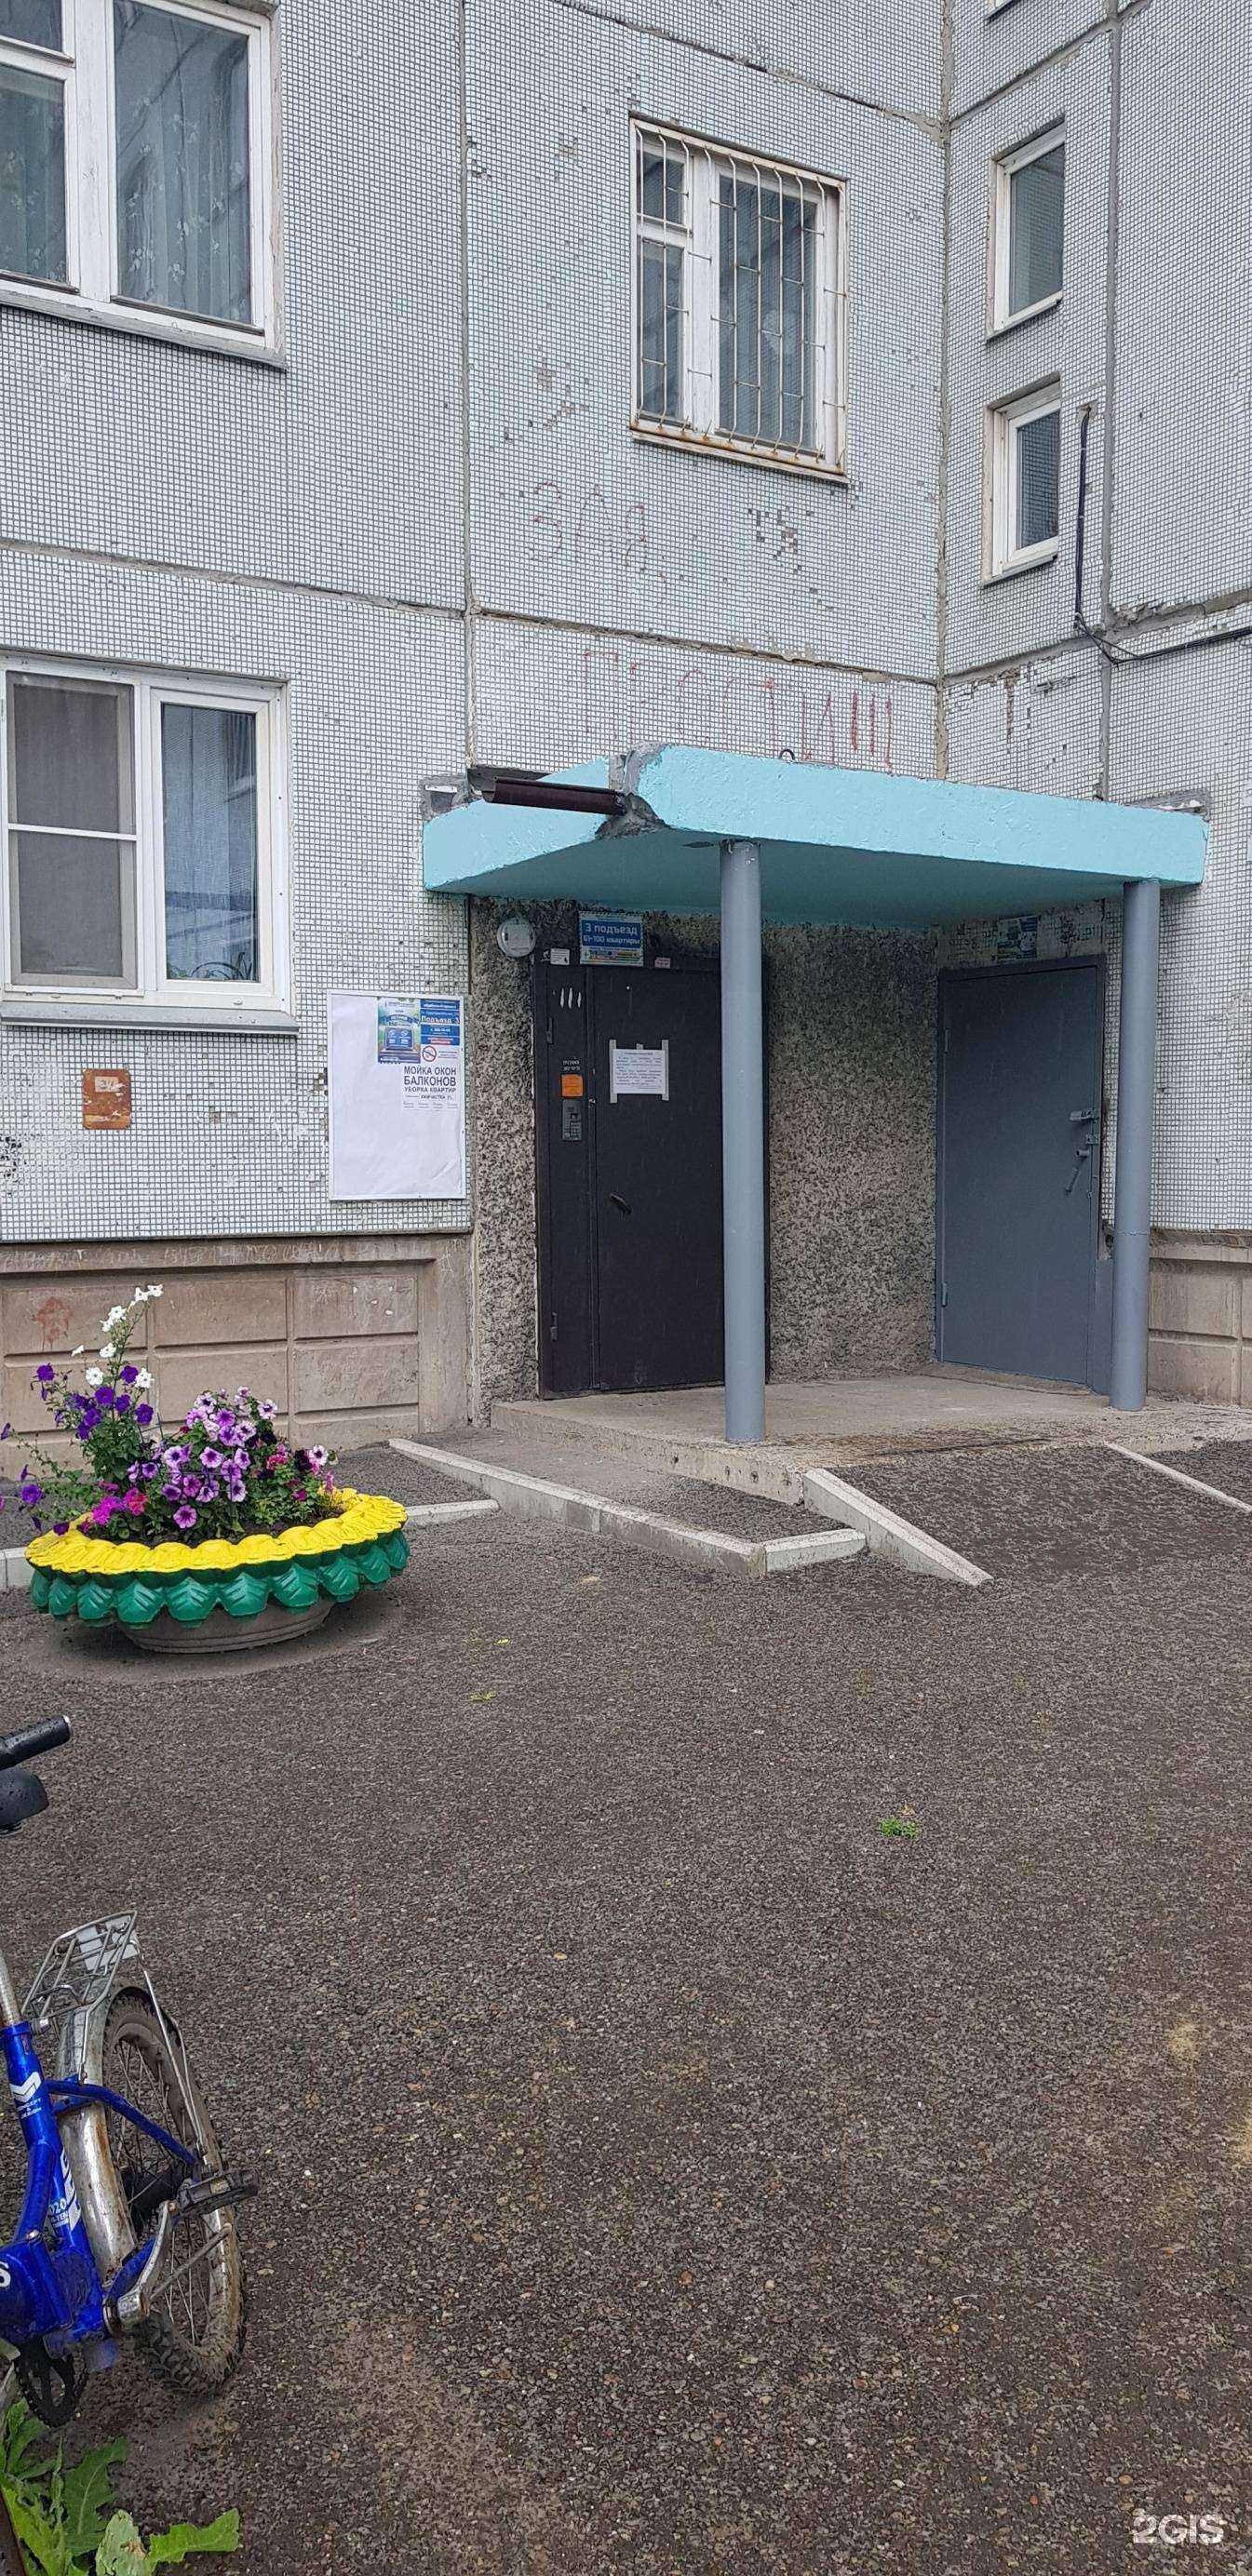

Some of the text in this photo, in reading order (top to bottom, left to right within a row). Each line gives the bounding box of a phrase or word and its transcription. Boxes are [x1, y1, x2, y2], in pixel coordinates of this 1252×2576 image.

[585, 923, 638, 936] 3 подъезд
[606, 937, 640, 946] квартиры
[404, 1066, 457, 1076] МОЙКА ОКОН
[404, 1075, 457, 1087] БАЛКОНОВ
